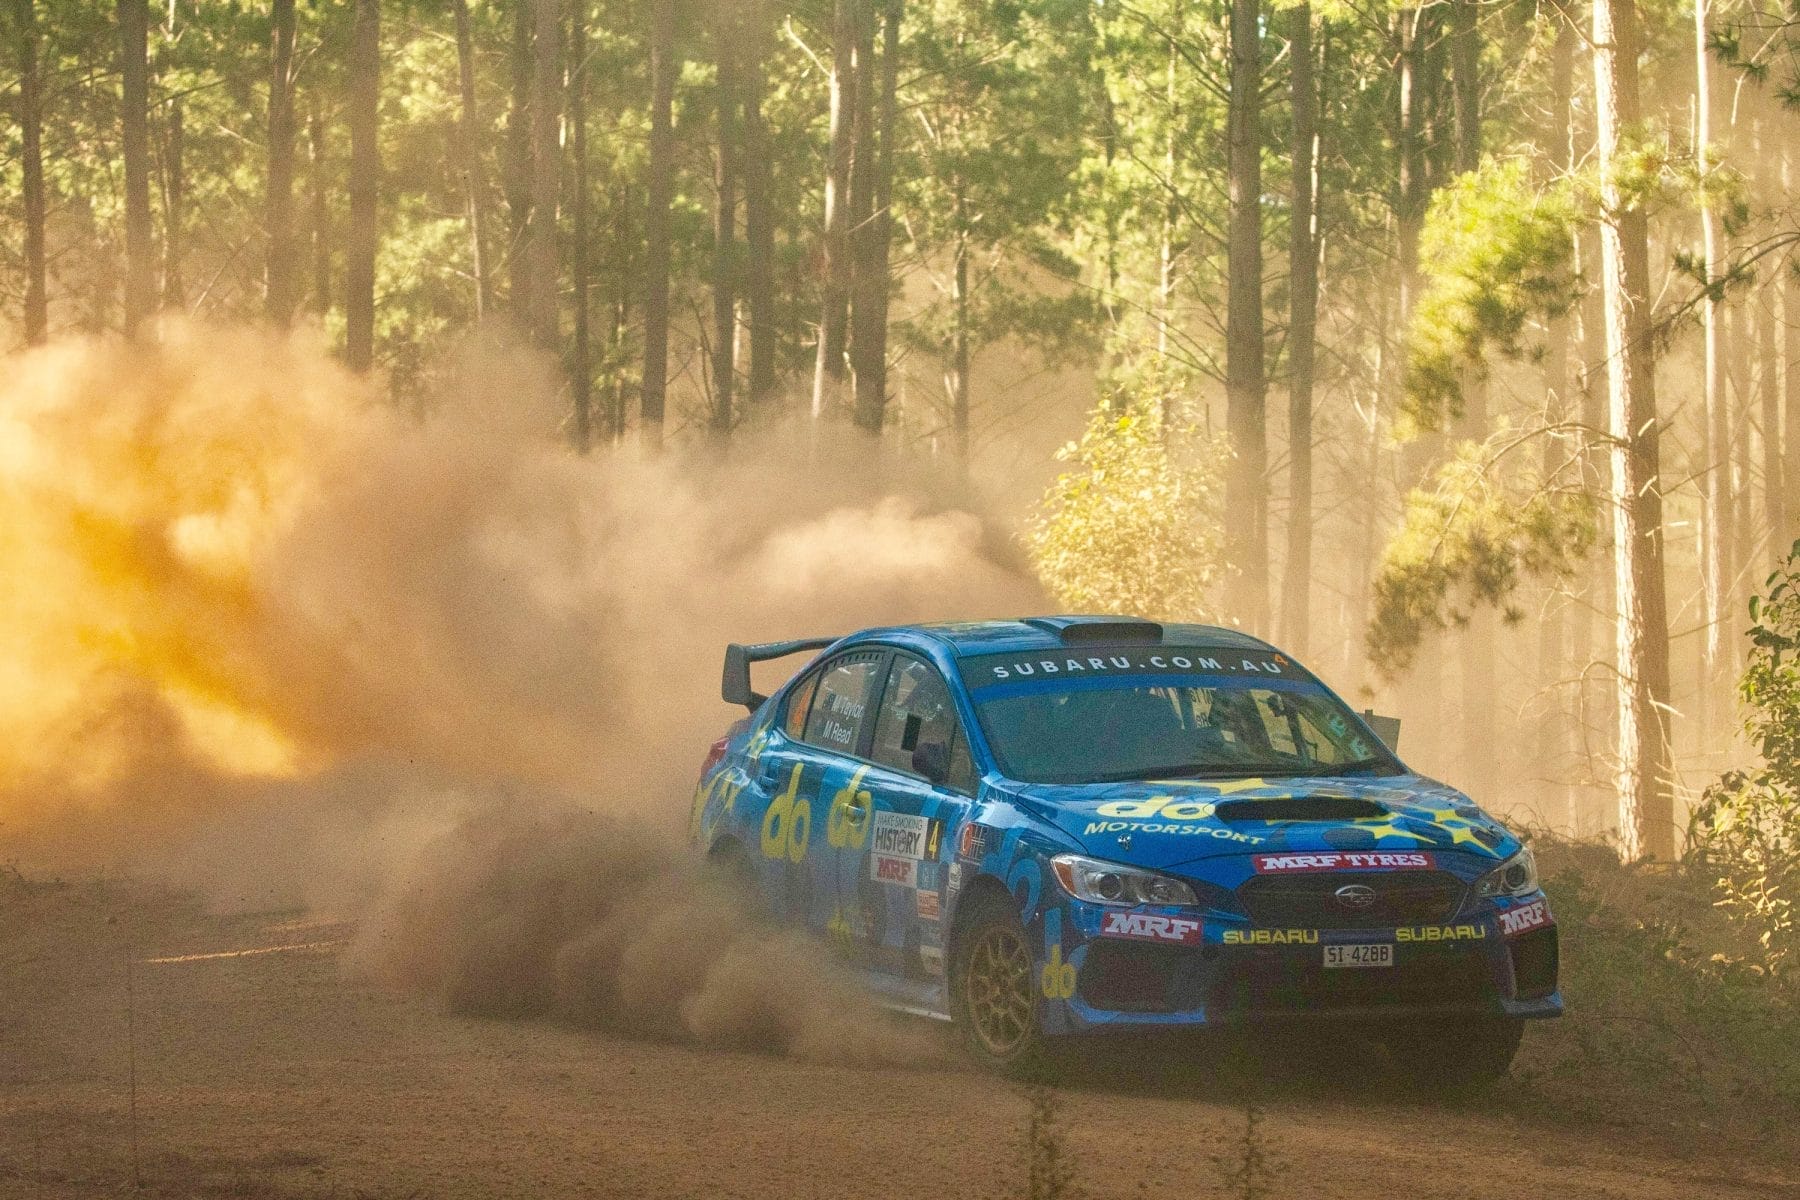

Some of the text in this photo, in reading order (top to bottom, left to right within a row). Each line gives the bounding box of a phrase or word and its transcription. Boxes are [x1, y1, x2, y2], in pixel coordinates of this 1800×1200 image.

[993, 656, 1281, 678] SUBARU.COM.AU
[822, 720, 854, 744] M Read
[1096, 796, 1216, 820] do
[928, 820, 939, 859] 4
[1083, 821, 1265, 845] MOTORSPORT
[877, 857, 912, 882] MRF
[1261, 854, 1428, 870] MRF TYRES
[1105, 913, 1199, 940] MRF
[1500, 901, 1544, 935] MRF
[1223, 929, 1319, 945] SUBARU
[1395, 925, 1486, 941] SUBARU
[1042, 944, 1077, 998] do
